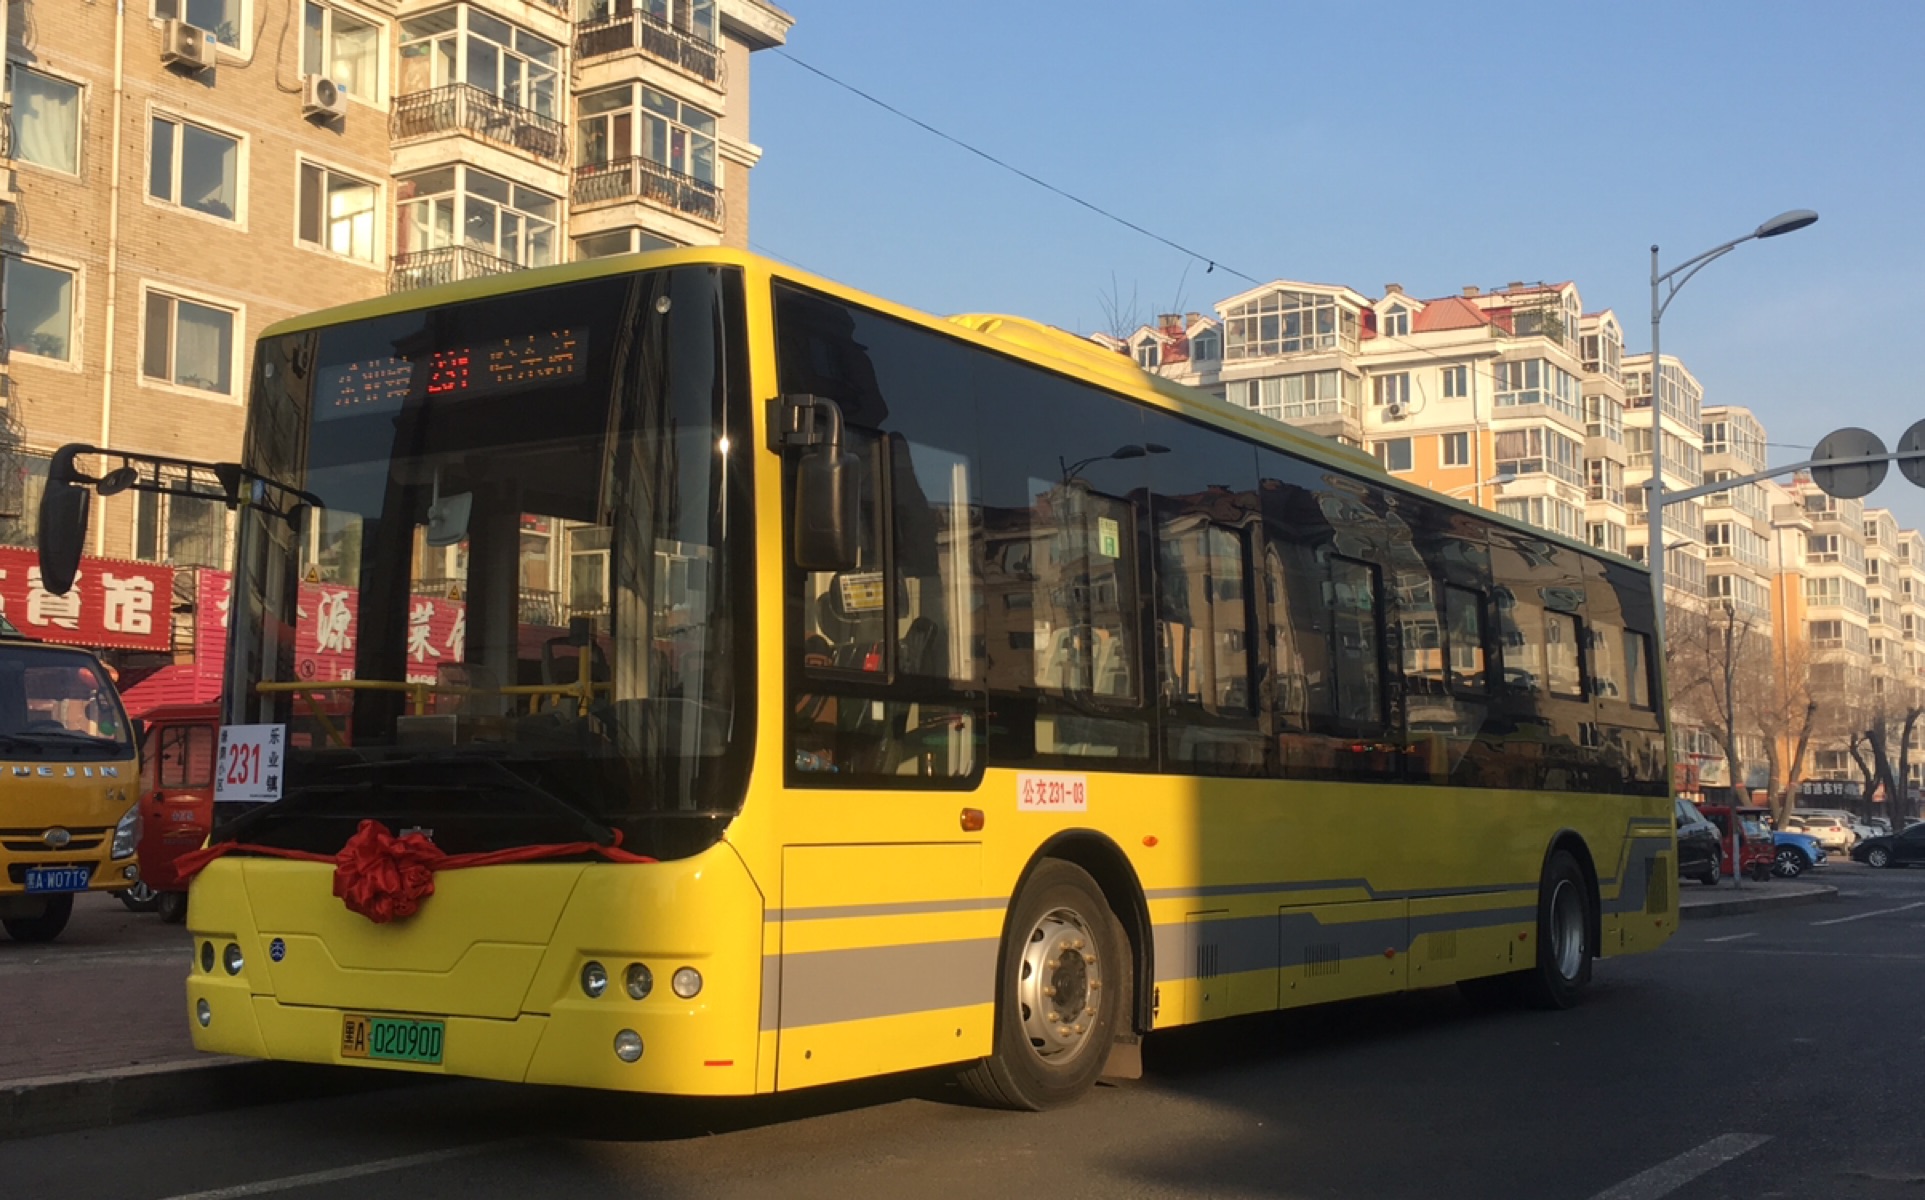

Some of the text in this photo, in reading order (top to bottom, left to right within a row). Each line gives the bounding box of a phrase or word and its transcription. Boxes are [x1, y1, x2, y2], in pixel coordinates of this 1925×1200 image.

[0, 566, 155, 634] 餐馆
[0, 766, 118, 777] UEJIN
[227, 743, 260, 784] 231
